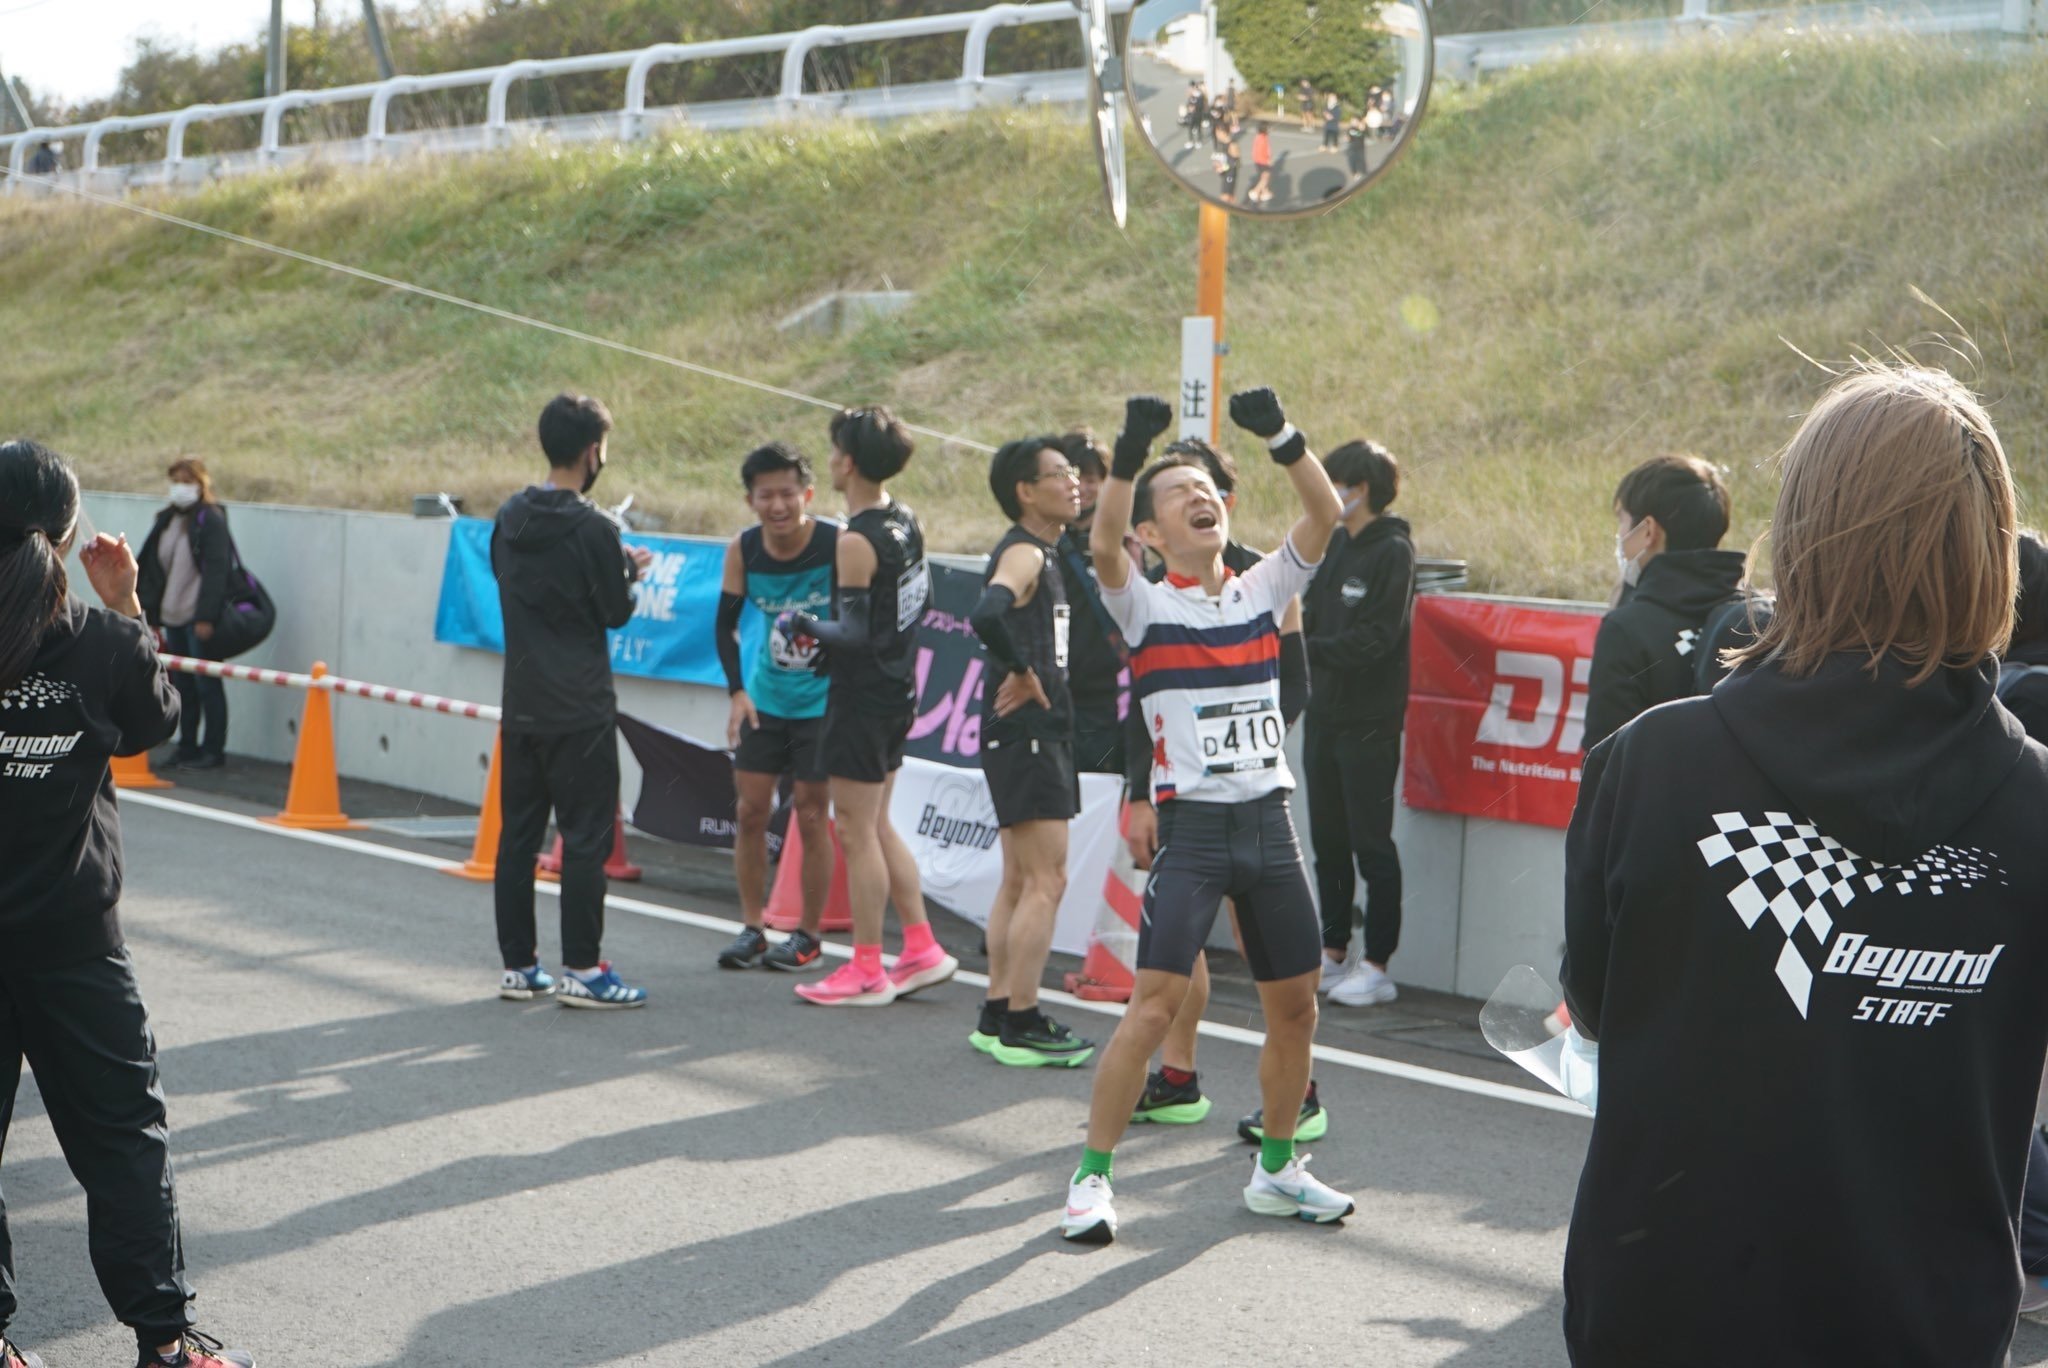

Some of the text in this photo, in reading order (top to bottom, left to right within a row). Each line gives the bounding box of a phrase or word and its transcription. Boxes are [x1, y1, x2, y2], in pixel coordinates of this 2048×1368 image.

[0, 731, 84, 758] eyond
[3, 762, 54, 779] STAFF
[1472, 755, 1495, 772] The
[1499, 758, 1567, 782] Nutrition
[1822, 932, 2006, 989] Beyond
[1852, 996, 1953, 1026] STAFF
